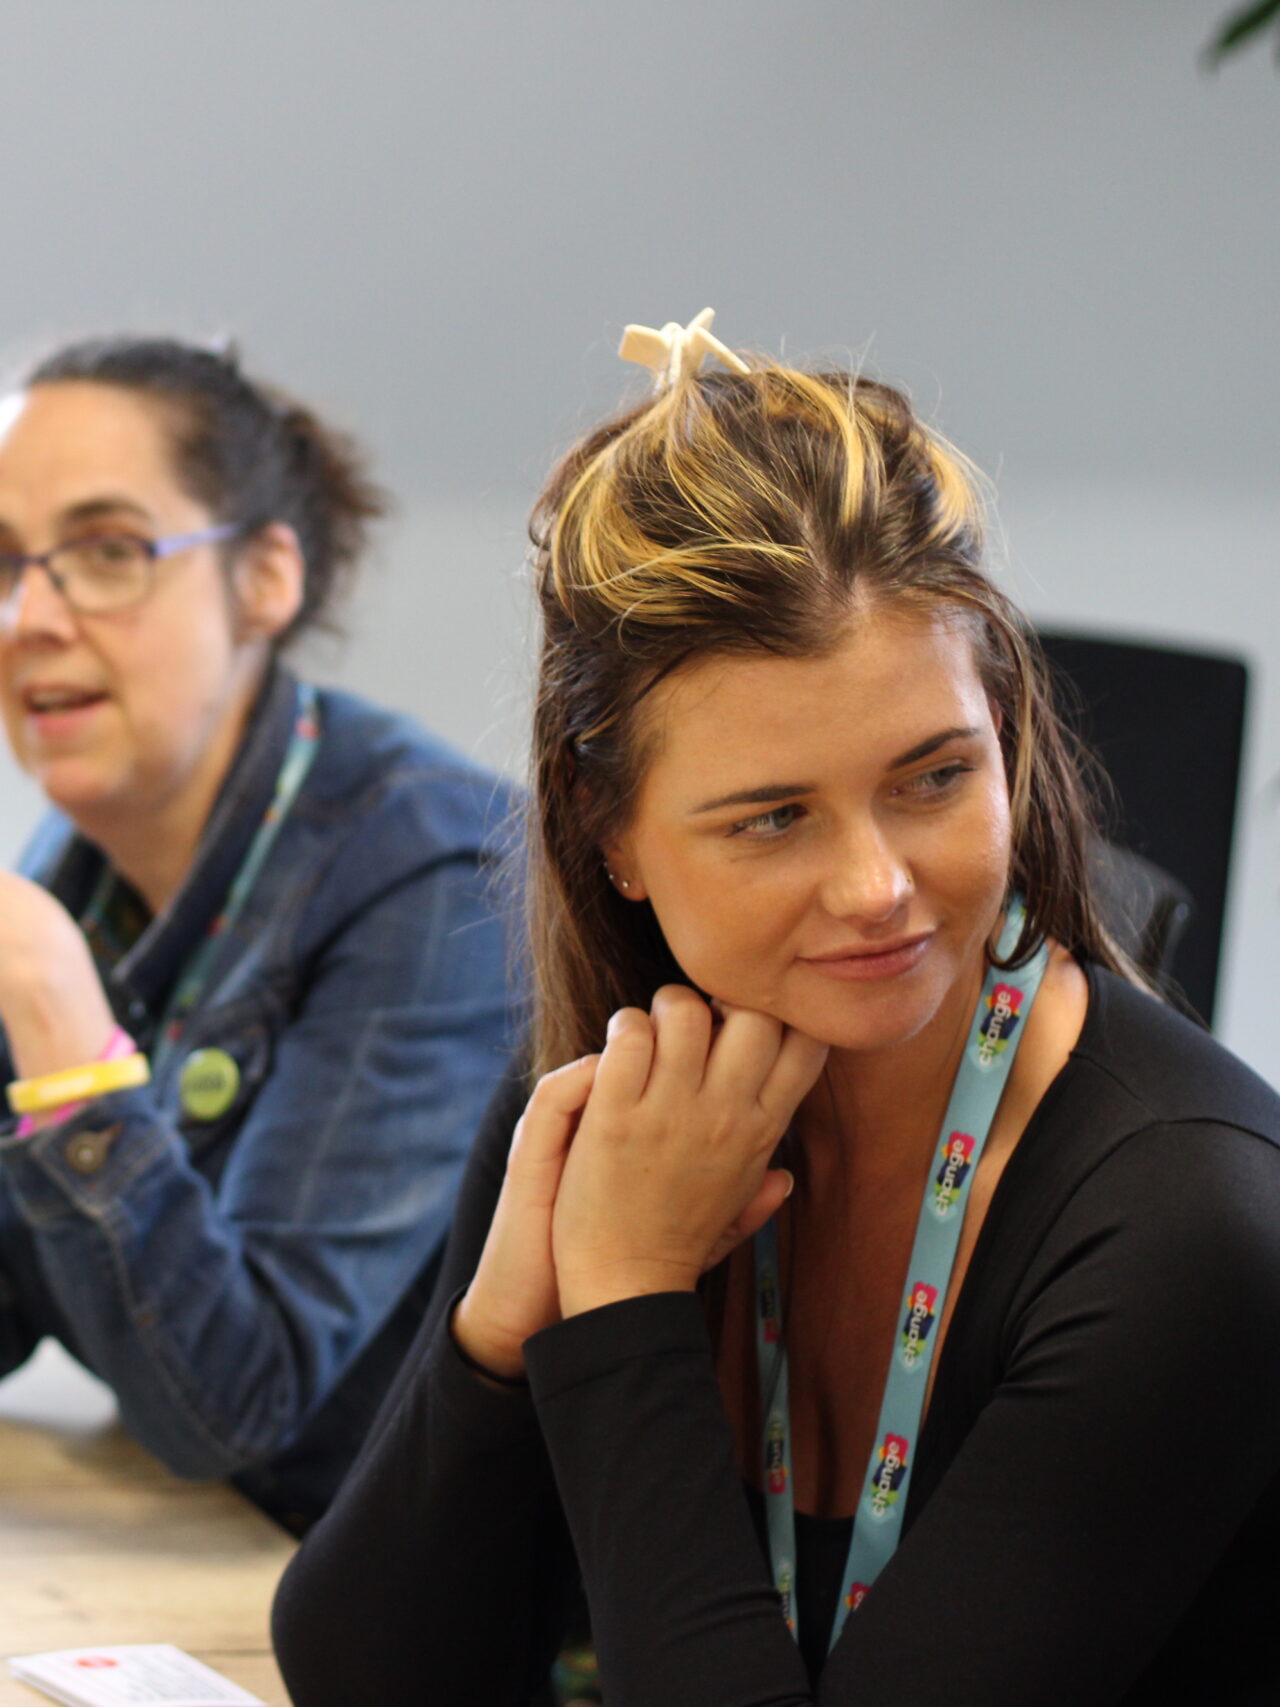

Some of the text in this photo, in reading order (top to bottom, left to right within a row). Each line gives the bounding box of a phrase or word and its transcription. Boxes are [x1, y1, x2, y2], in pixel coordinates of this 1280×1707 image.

[979, 990, 1012, 1065] change
[935, 1139, 965, 1216] change
[903, 1290, 928, 1367] change
[872, 1441, 901, 1517] change
